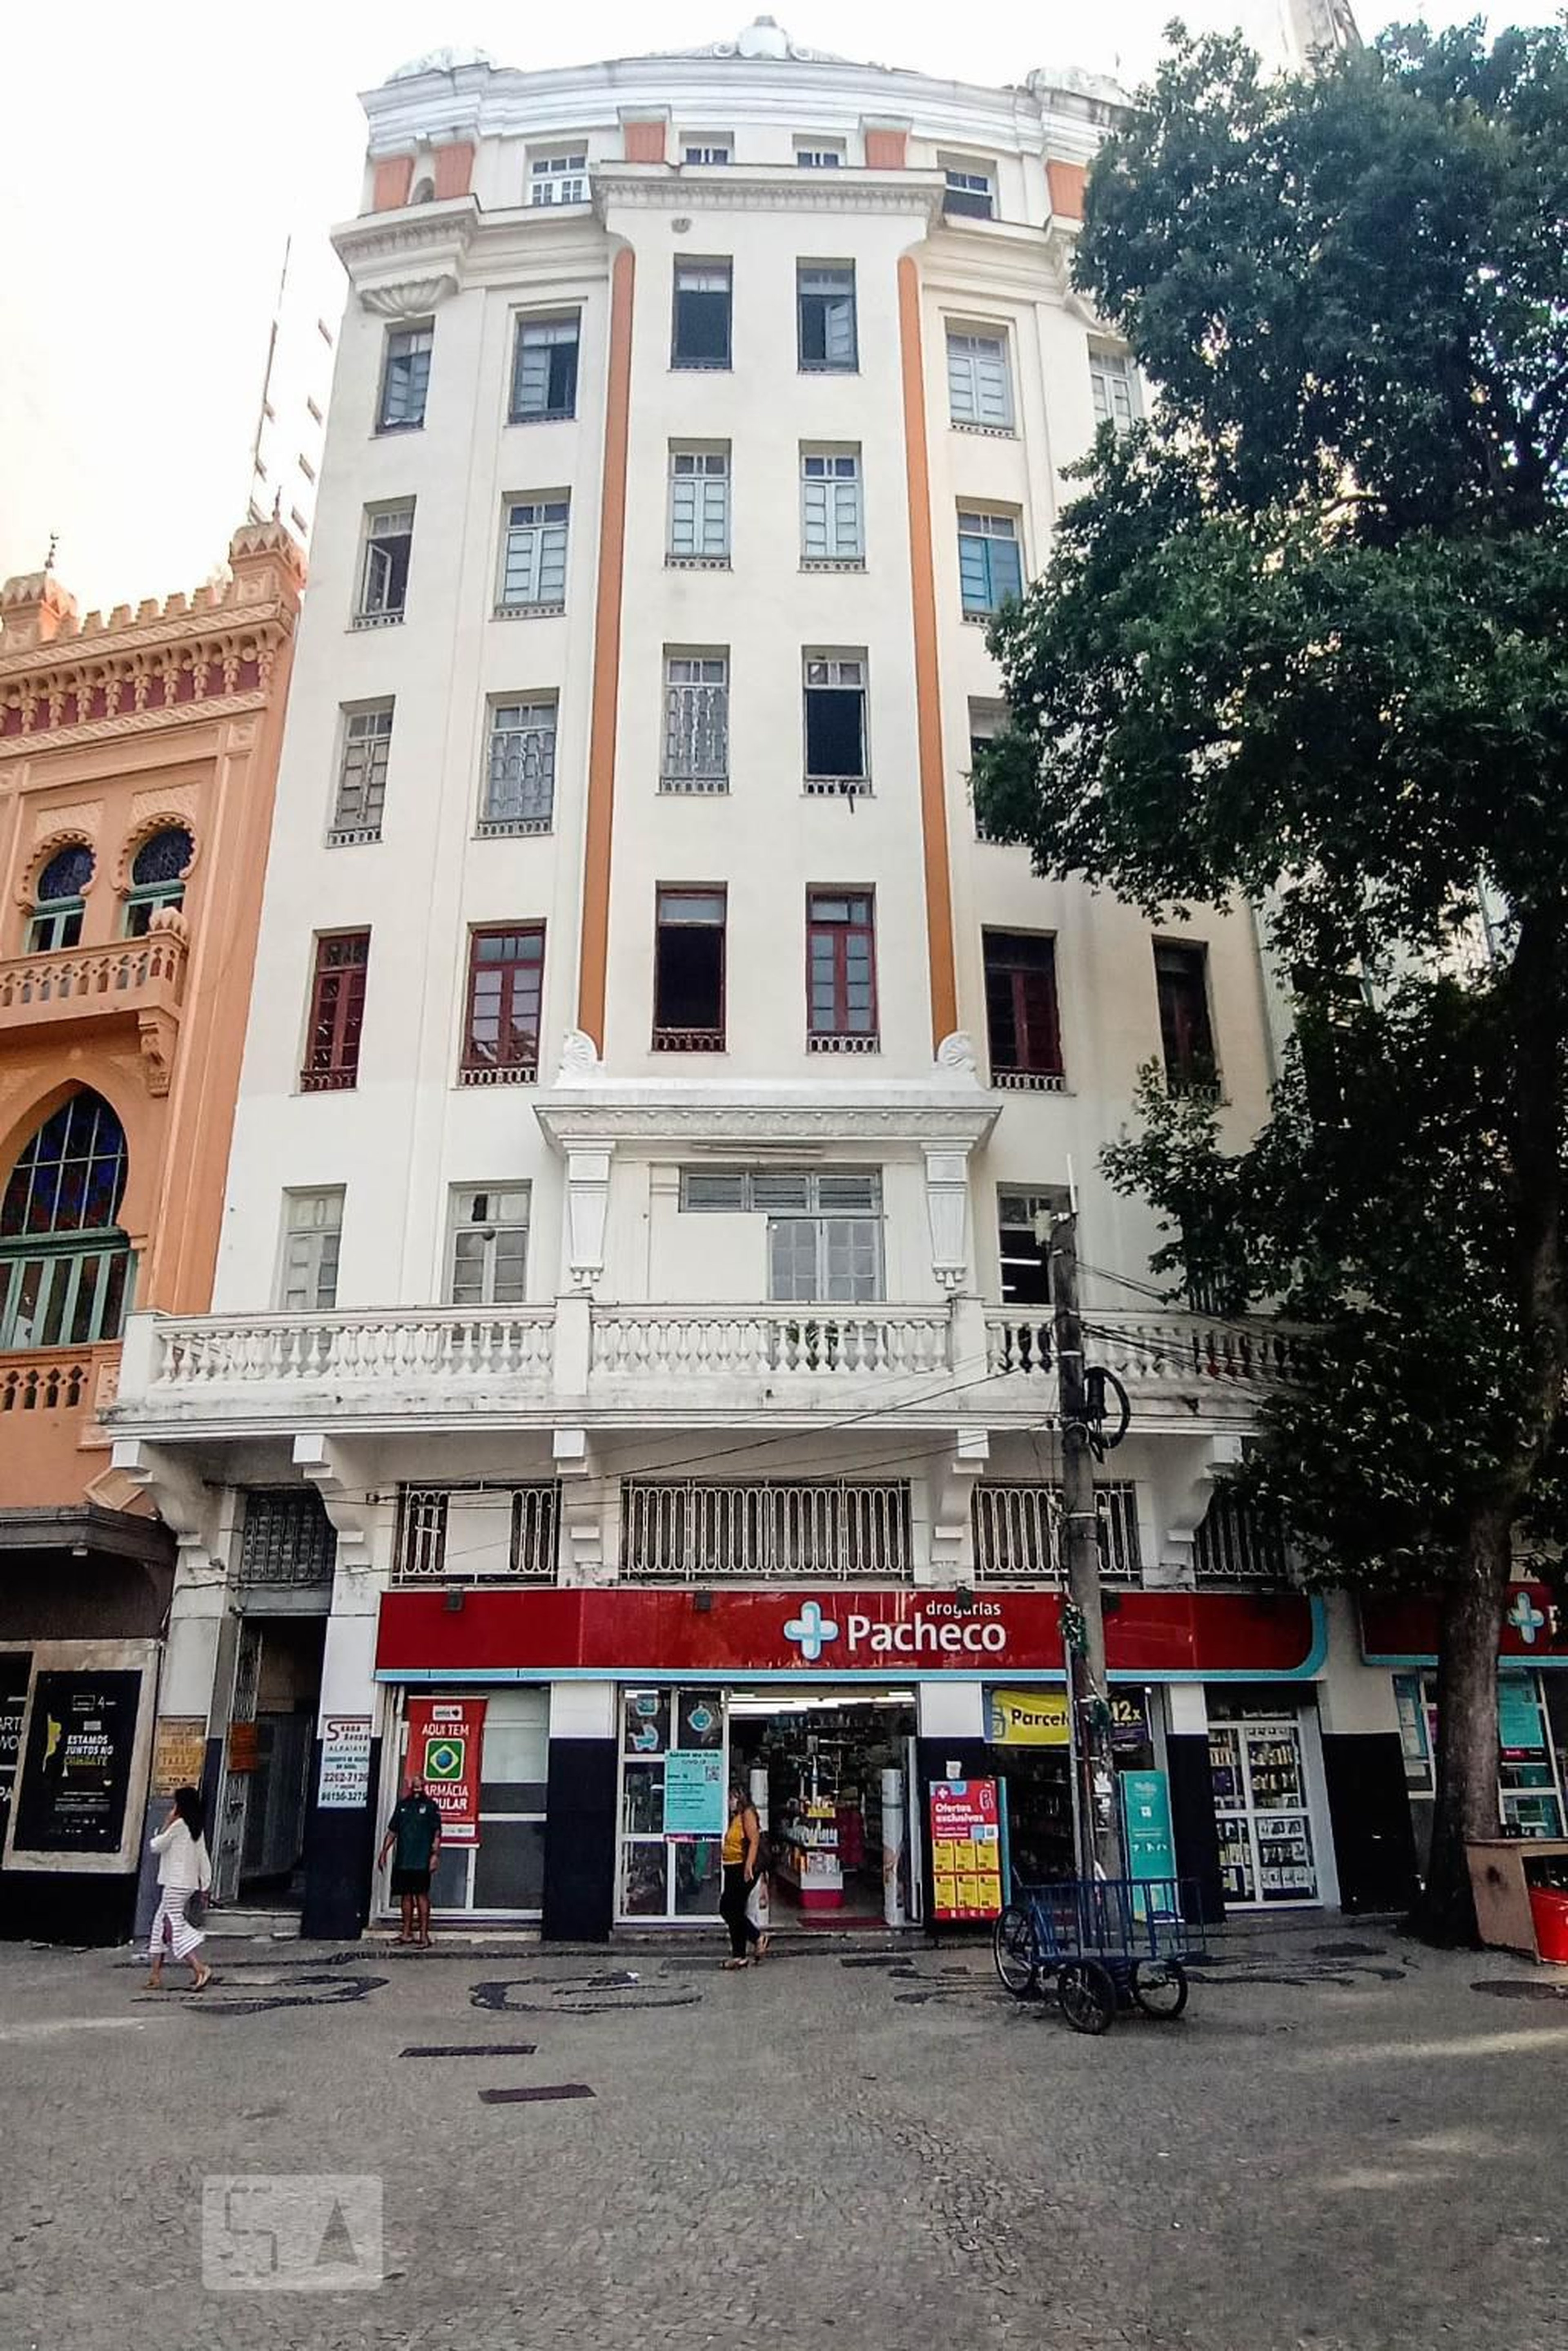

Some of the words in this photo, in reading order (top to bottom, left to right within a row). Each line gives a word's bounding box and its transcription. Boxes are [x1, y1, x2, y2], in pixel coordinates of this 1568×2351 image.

[848, 1612, 1006, 1651] Pacheco
[1111, 1701, 1142, 1722] 12x
[422, 1723, 446, 1736] AQUI
[448, 1723, 470, 1736] TEM
[67, 1735, 108, 1744] ESTAMOS
[65, 1745, 99, 1755] JUNTOS
[100, 1745, 114, 1755] NO
[424, 1783, 469, 1797] ARMÁCIA
[432, 1798, 468, 1810] ULAR
